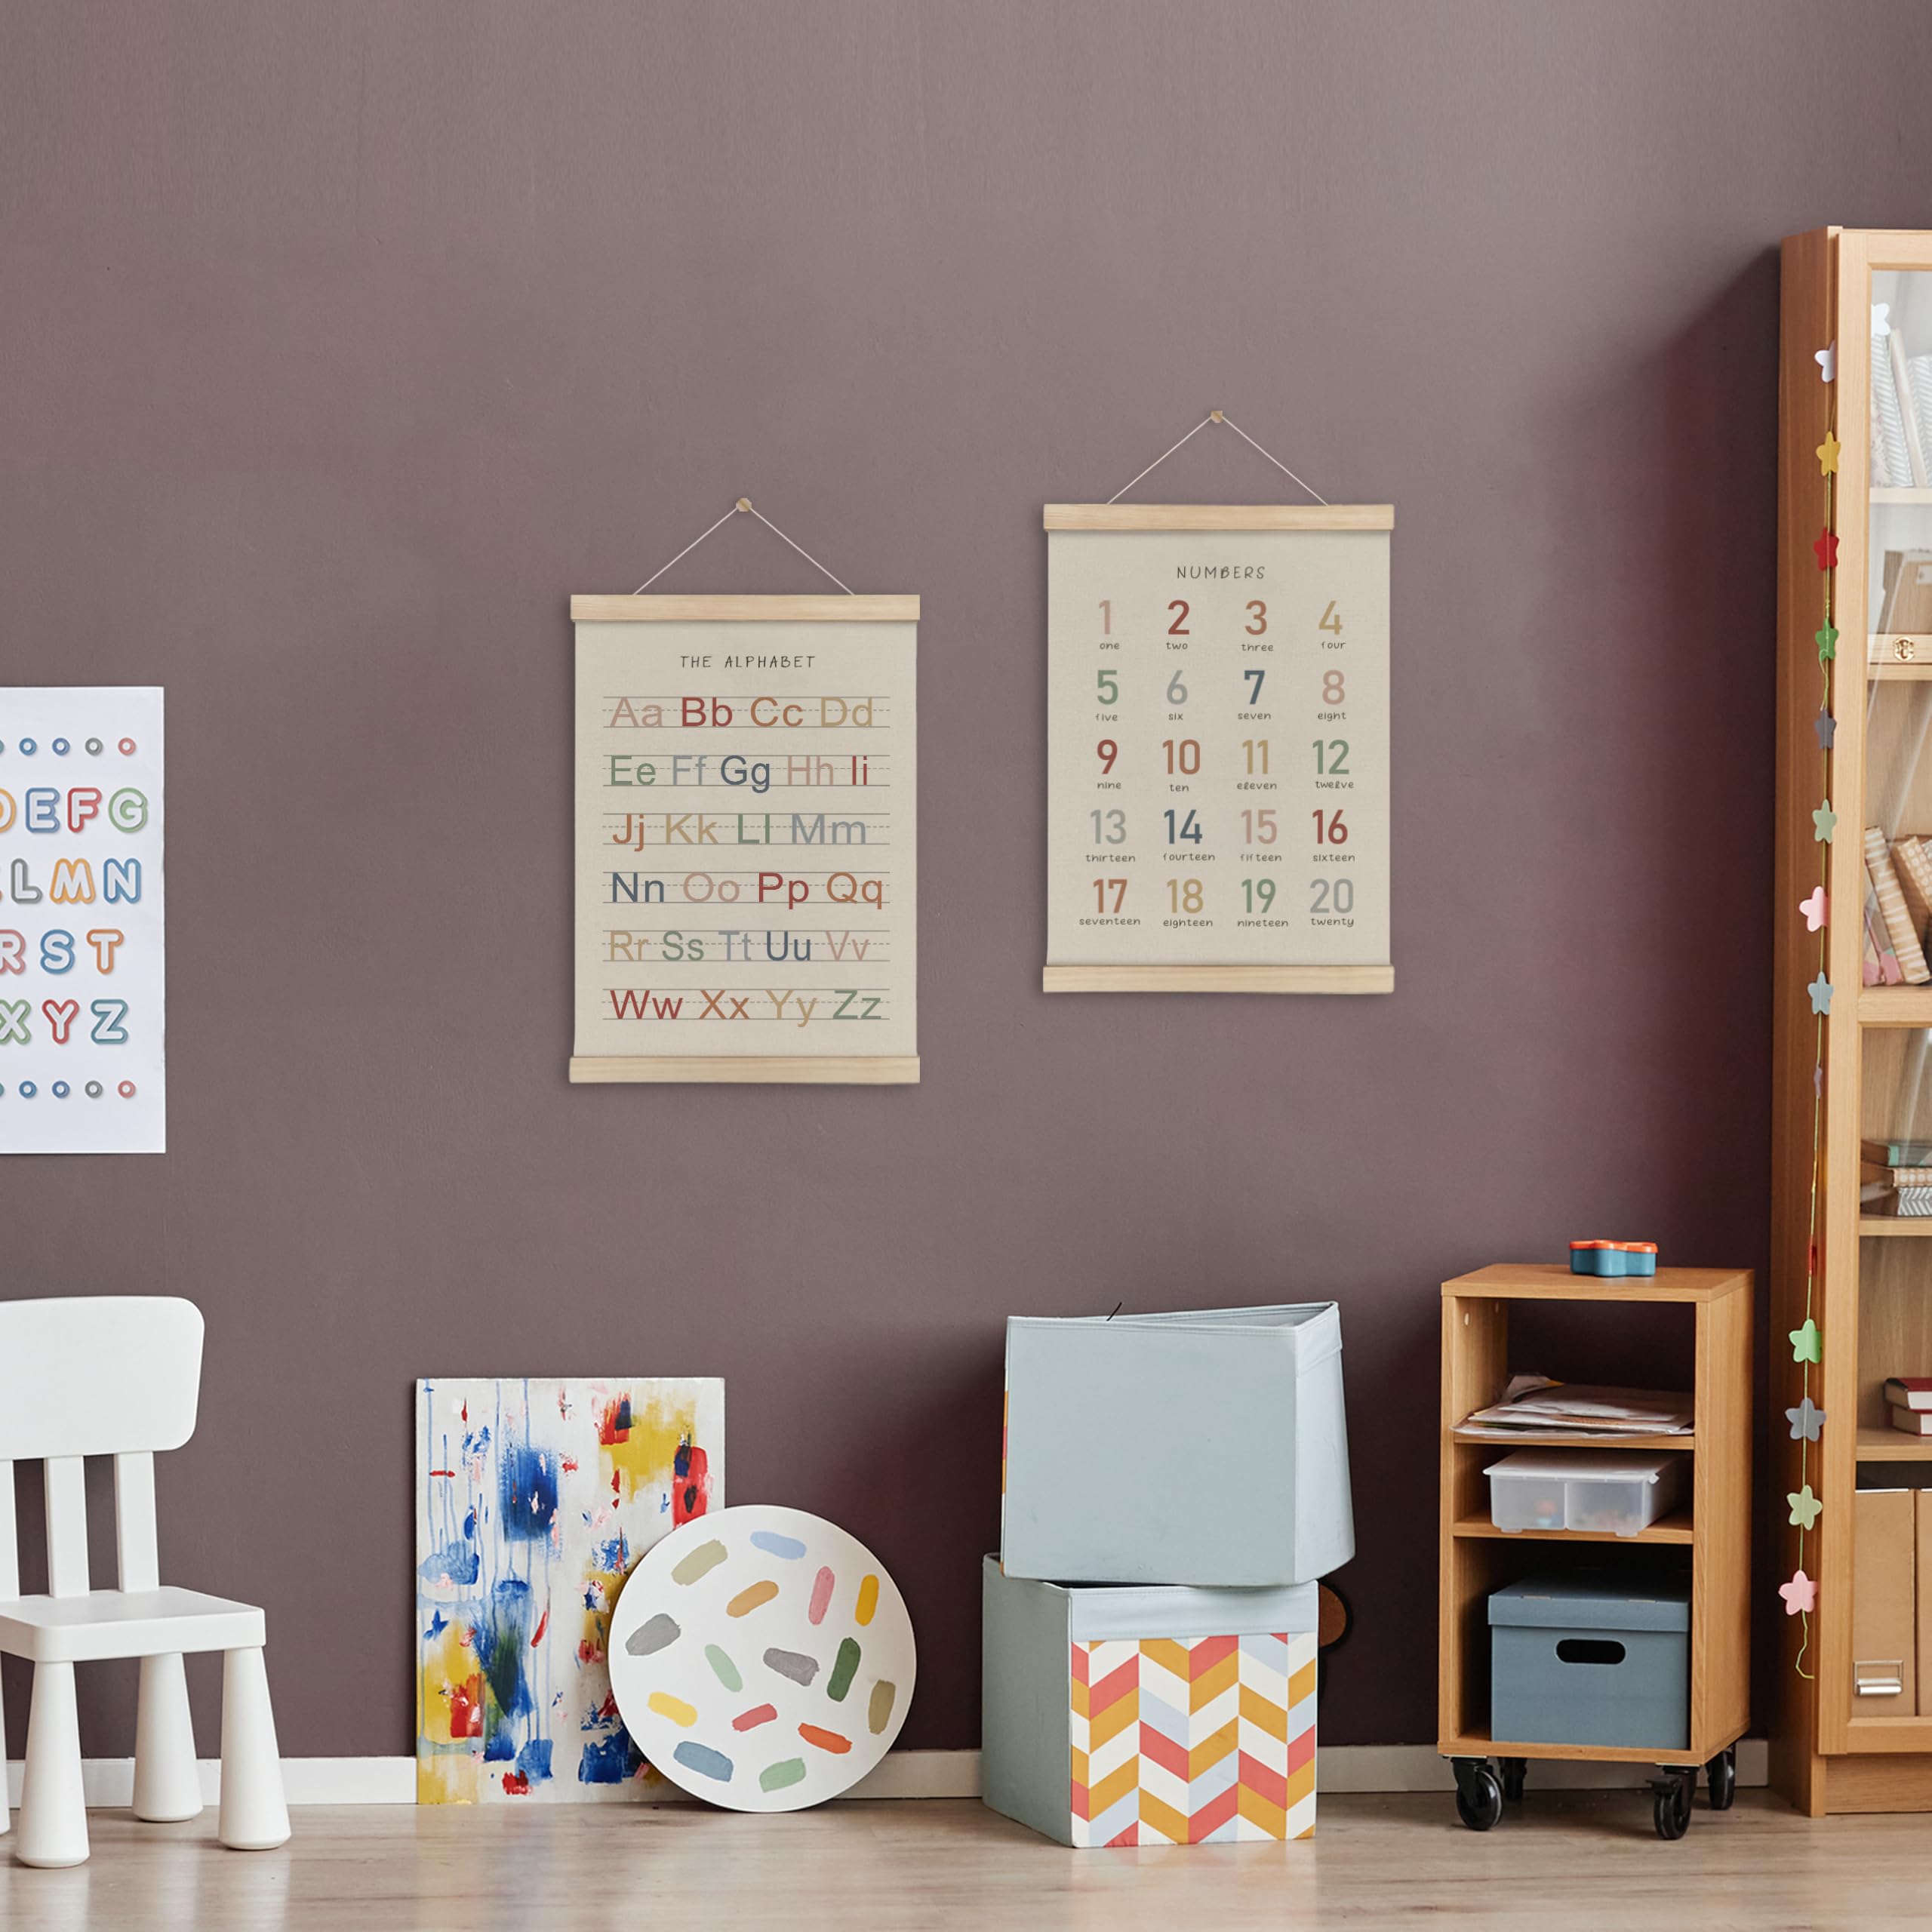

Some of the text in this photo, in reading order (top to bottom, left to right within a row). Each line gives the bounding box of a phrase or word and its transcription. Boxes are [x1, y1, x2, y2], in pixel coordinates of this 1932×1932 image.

[1177, 566, 1265, 579] NUMBERS
[1100, 600, 1343, 635] 1 2 3 4
[1165, 641, 1189, 651] two
[1241, 644, 1274, 652] three
[1321, 641, 1346, 650] four
[681, 656, 816, 669] THE ALPHABET
[1097, 670, 1345, 705] 5 6 7 8
[610, 697, 873, 728] Aa Bb Cc Dd
[1095, 713, 1118, 721] five
[1168, 712, 1183, 721] six
[1317, 712, 1347, 722] eight
[1097, 740, 1349, 775] 9 10 11 12
[611, 755, 868, 793] Ee Ff Gg Hh Ii
[1097, 781, 1121, 790] nine
[1169, 784, 1189, 792] ten
[1236, 781, 1278, 790] eleven
[1315, 780, 1354, 789] twelve
[1091, 809, 1348, 844] 13 14 15 16
[613, 814, 866, 852] Jj Kk Ll Mm
[1085, 854, 1136, 863] thirteen
[1162, 853, 1216, 861] fourteen
[1240, 854, 1282, 862] fifteen
[1312, 854, 1355, 862] sixteen
[612, 872, 882, 909] Nn Oo Pp Qq
[1094, 878, 1353, 913] 17 18 19 20
[1162, 918, 1214, 929] eighteen
[1237, 919, 1289, 928] nineteen
[1310, 918, 1355, 928] twenty
[610, 931, 869, 961] Rr Ss Tt Uu Vv
[610, 990, 881, 1027] Ww Xx Yy Zz
